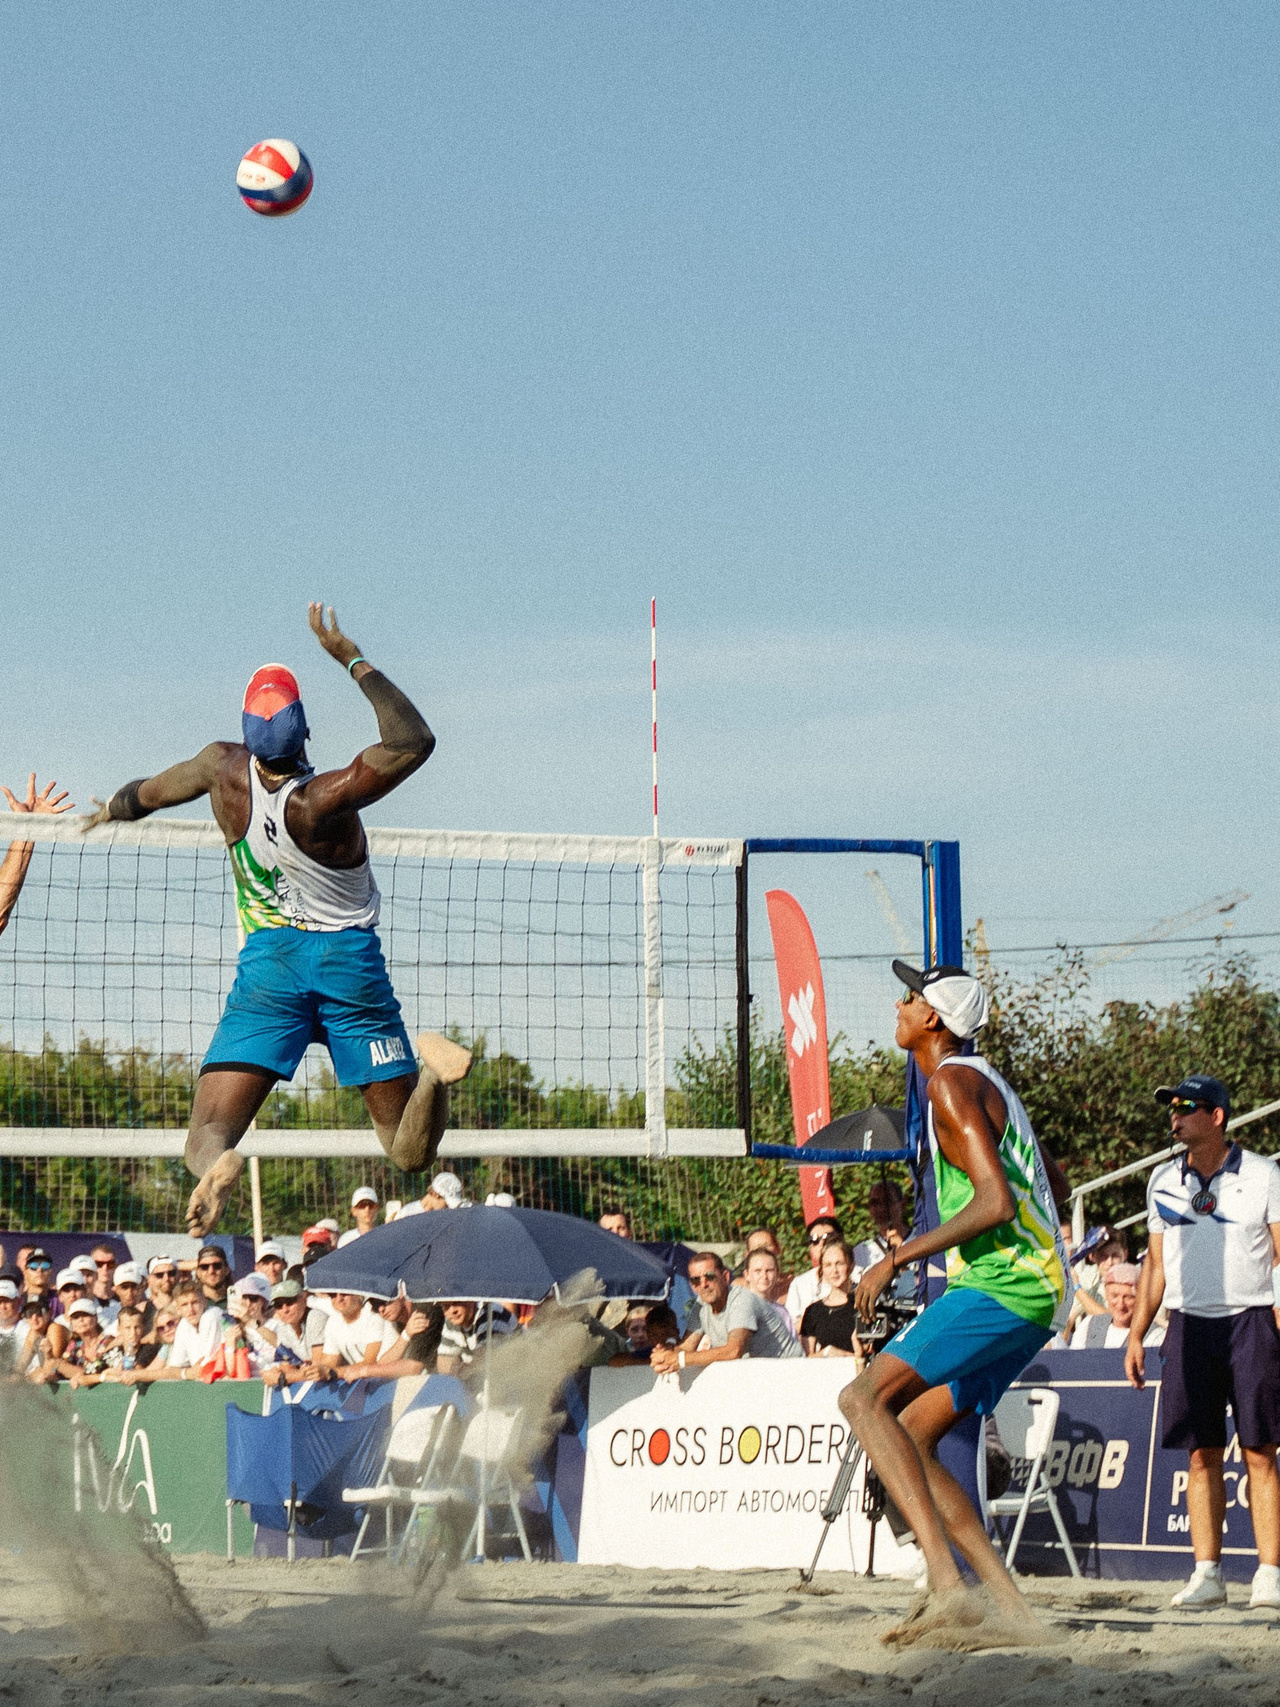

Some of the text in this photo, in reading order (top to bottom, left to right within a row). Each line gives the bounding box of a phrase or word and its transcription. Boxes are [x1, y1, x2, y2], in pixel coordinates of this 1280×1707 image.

[609, 1427, 707, 1467] CROSS
[1044, 1439, 1130, 1490] ВФВ
[650, 1489, 860, 1513] ИМПОРТ АВТОМОБЛ
